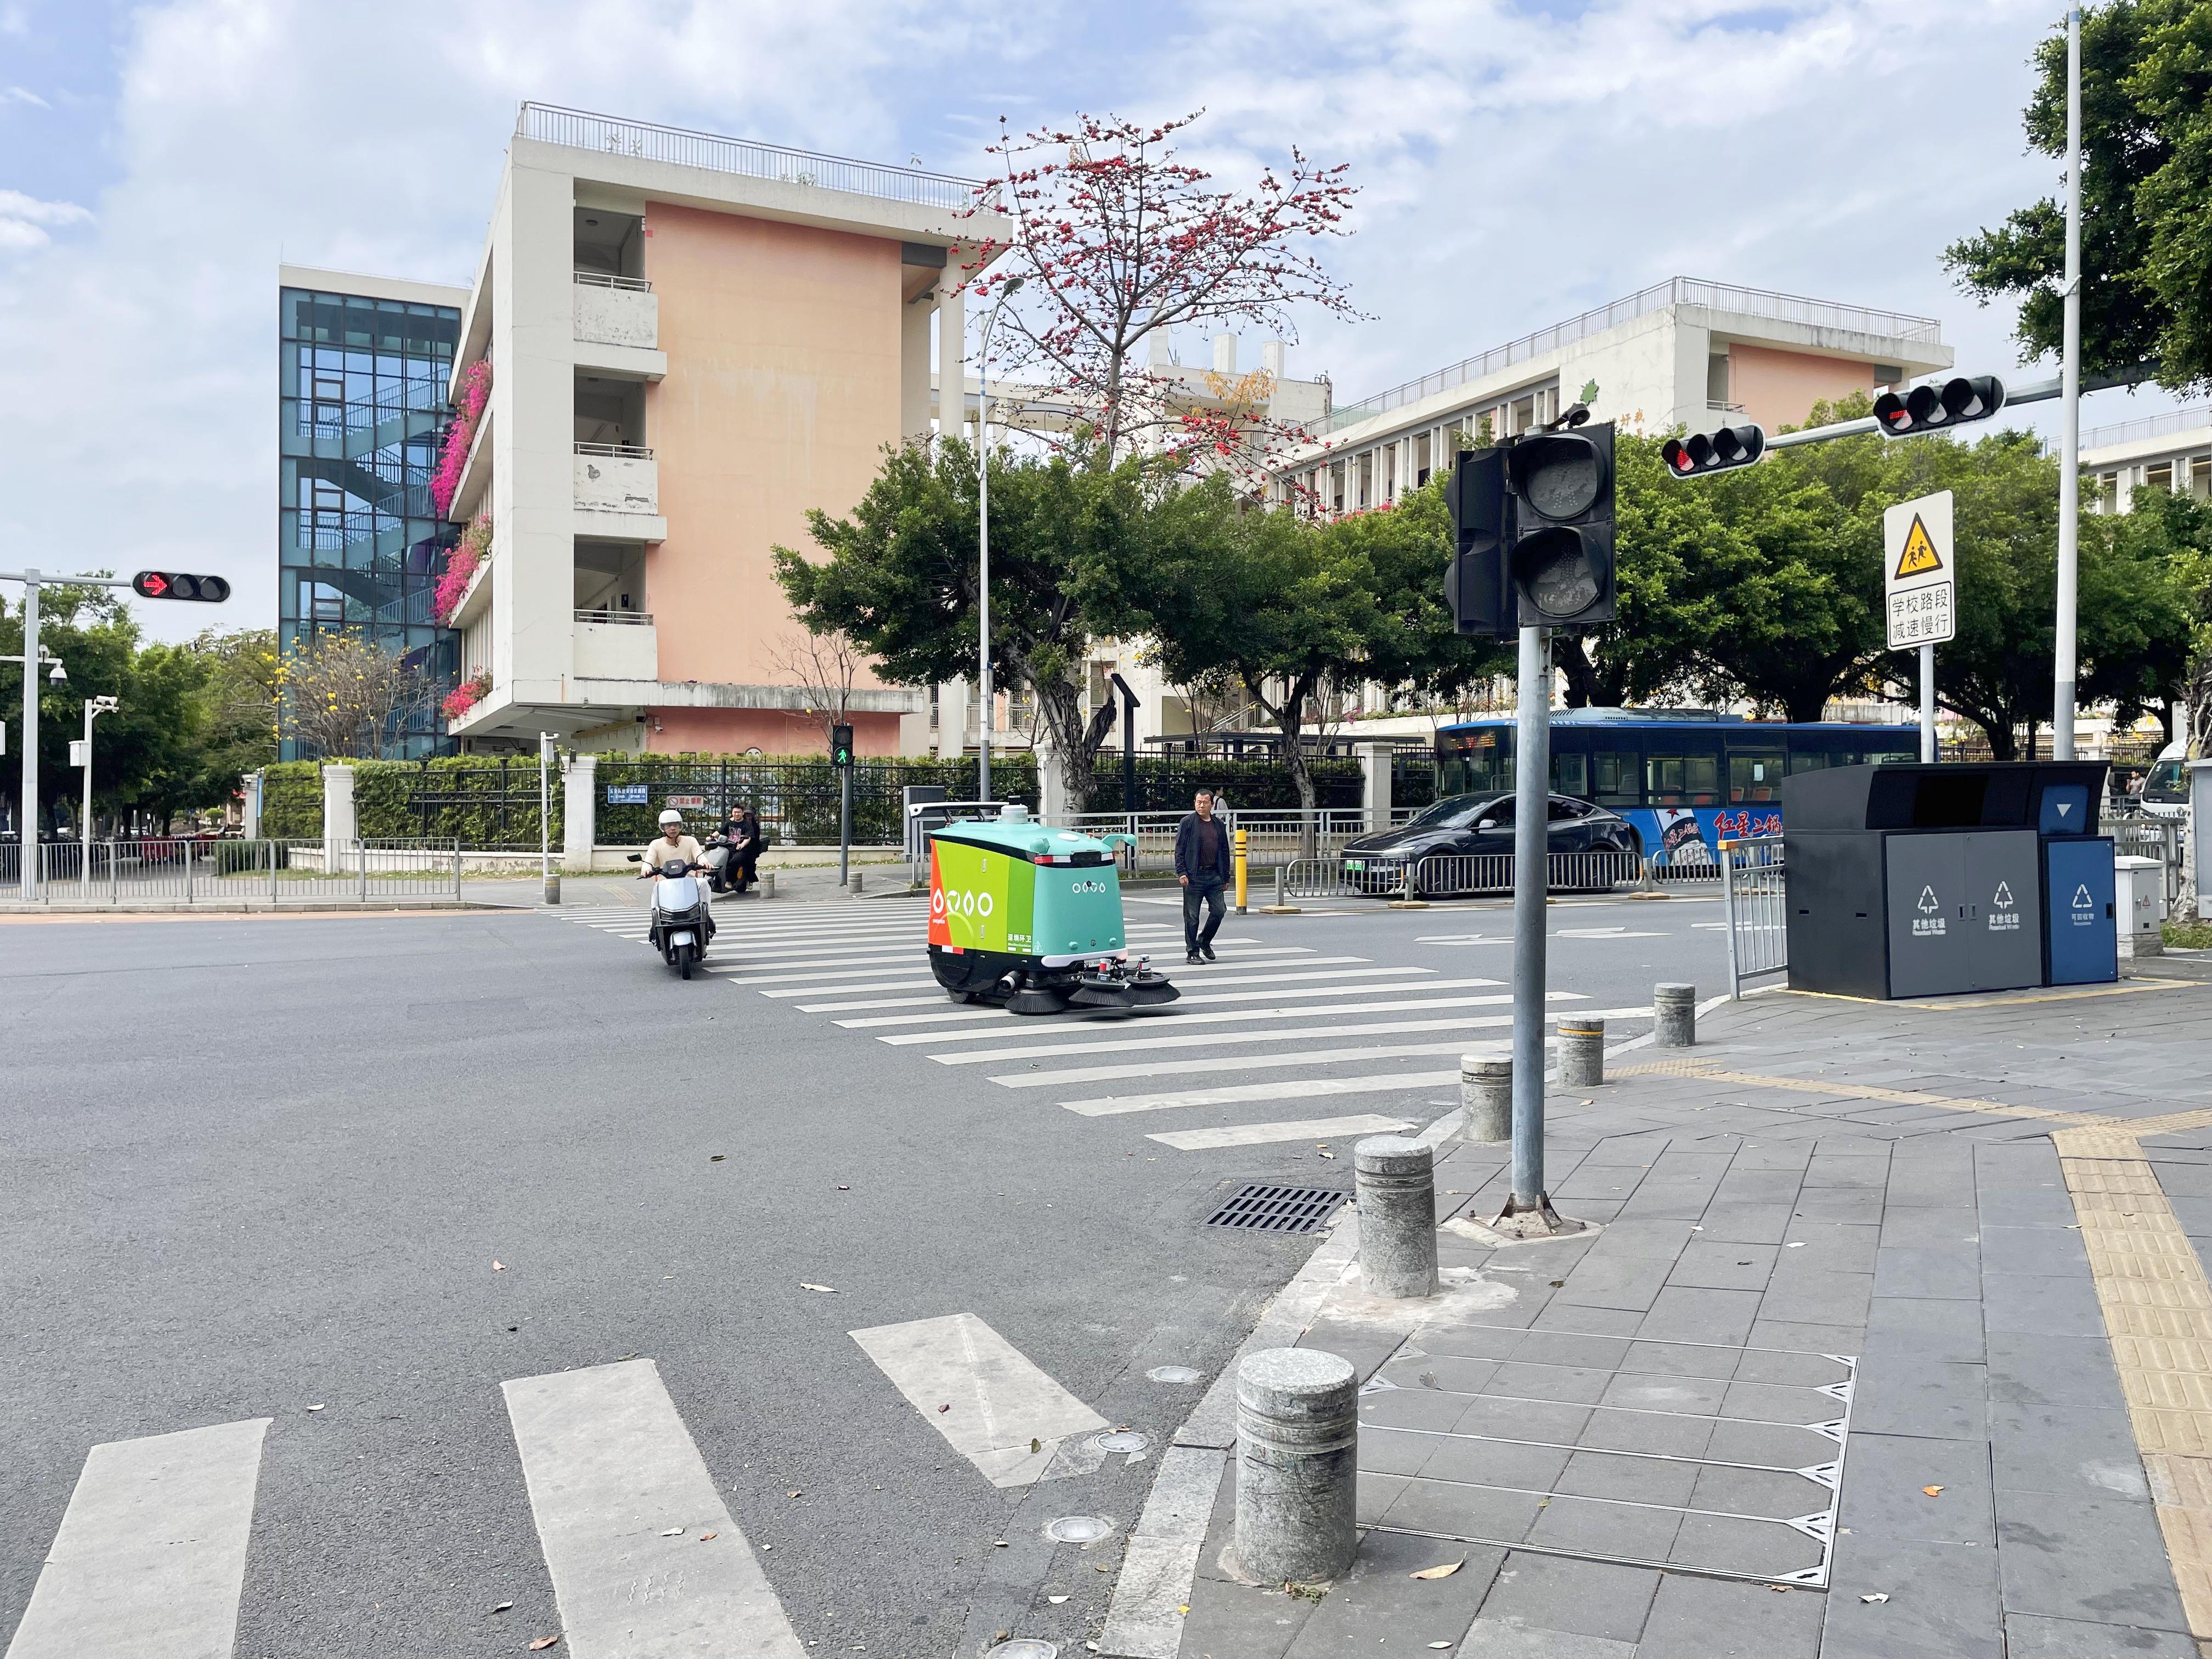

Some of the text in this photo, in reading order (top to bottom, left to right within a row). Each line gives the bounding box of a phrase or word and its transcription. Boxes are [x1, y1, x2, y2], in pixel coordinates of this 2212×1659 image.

[1893, 589, 1948, 617] 学校路段
[1893, 614, 1948, 640] 减速慢行
[1988, 913, 2019, 925] 其他垃圾
[2071, 913, 2094, 921] 可回收物
[1912, 918, 1946, 930] 其他垃圾
